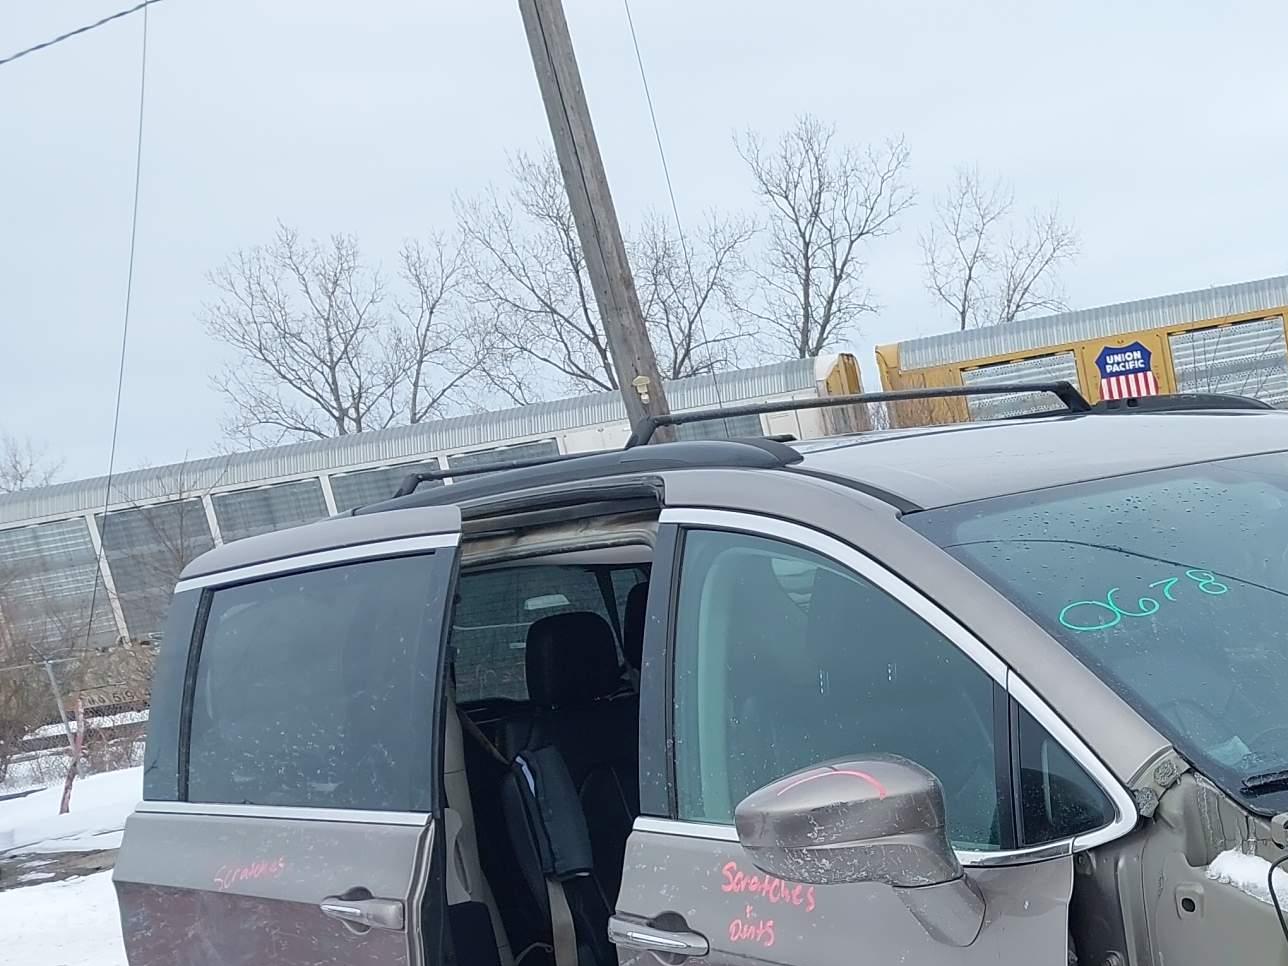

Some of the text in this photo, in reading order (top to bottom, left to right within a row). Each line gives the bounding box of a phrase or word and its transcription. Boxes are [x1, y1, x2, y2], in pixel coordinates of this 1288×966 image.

[1105, 350, 1142, 364] UNION
[1105, 360, 1145, 373] PACIFIC
[1059, 569, 1228, 631] 0678
